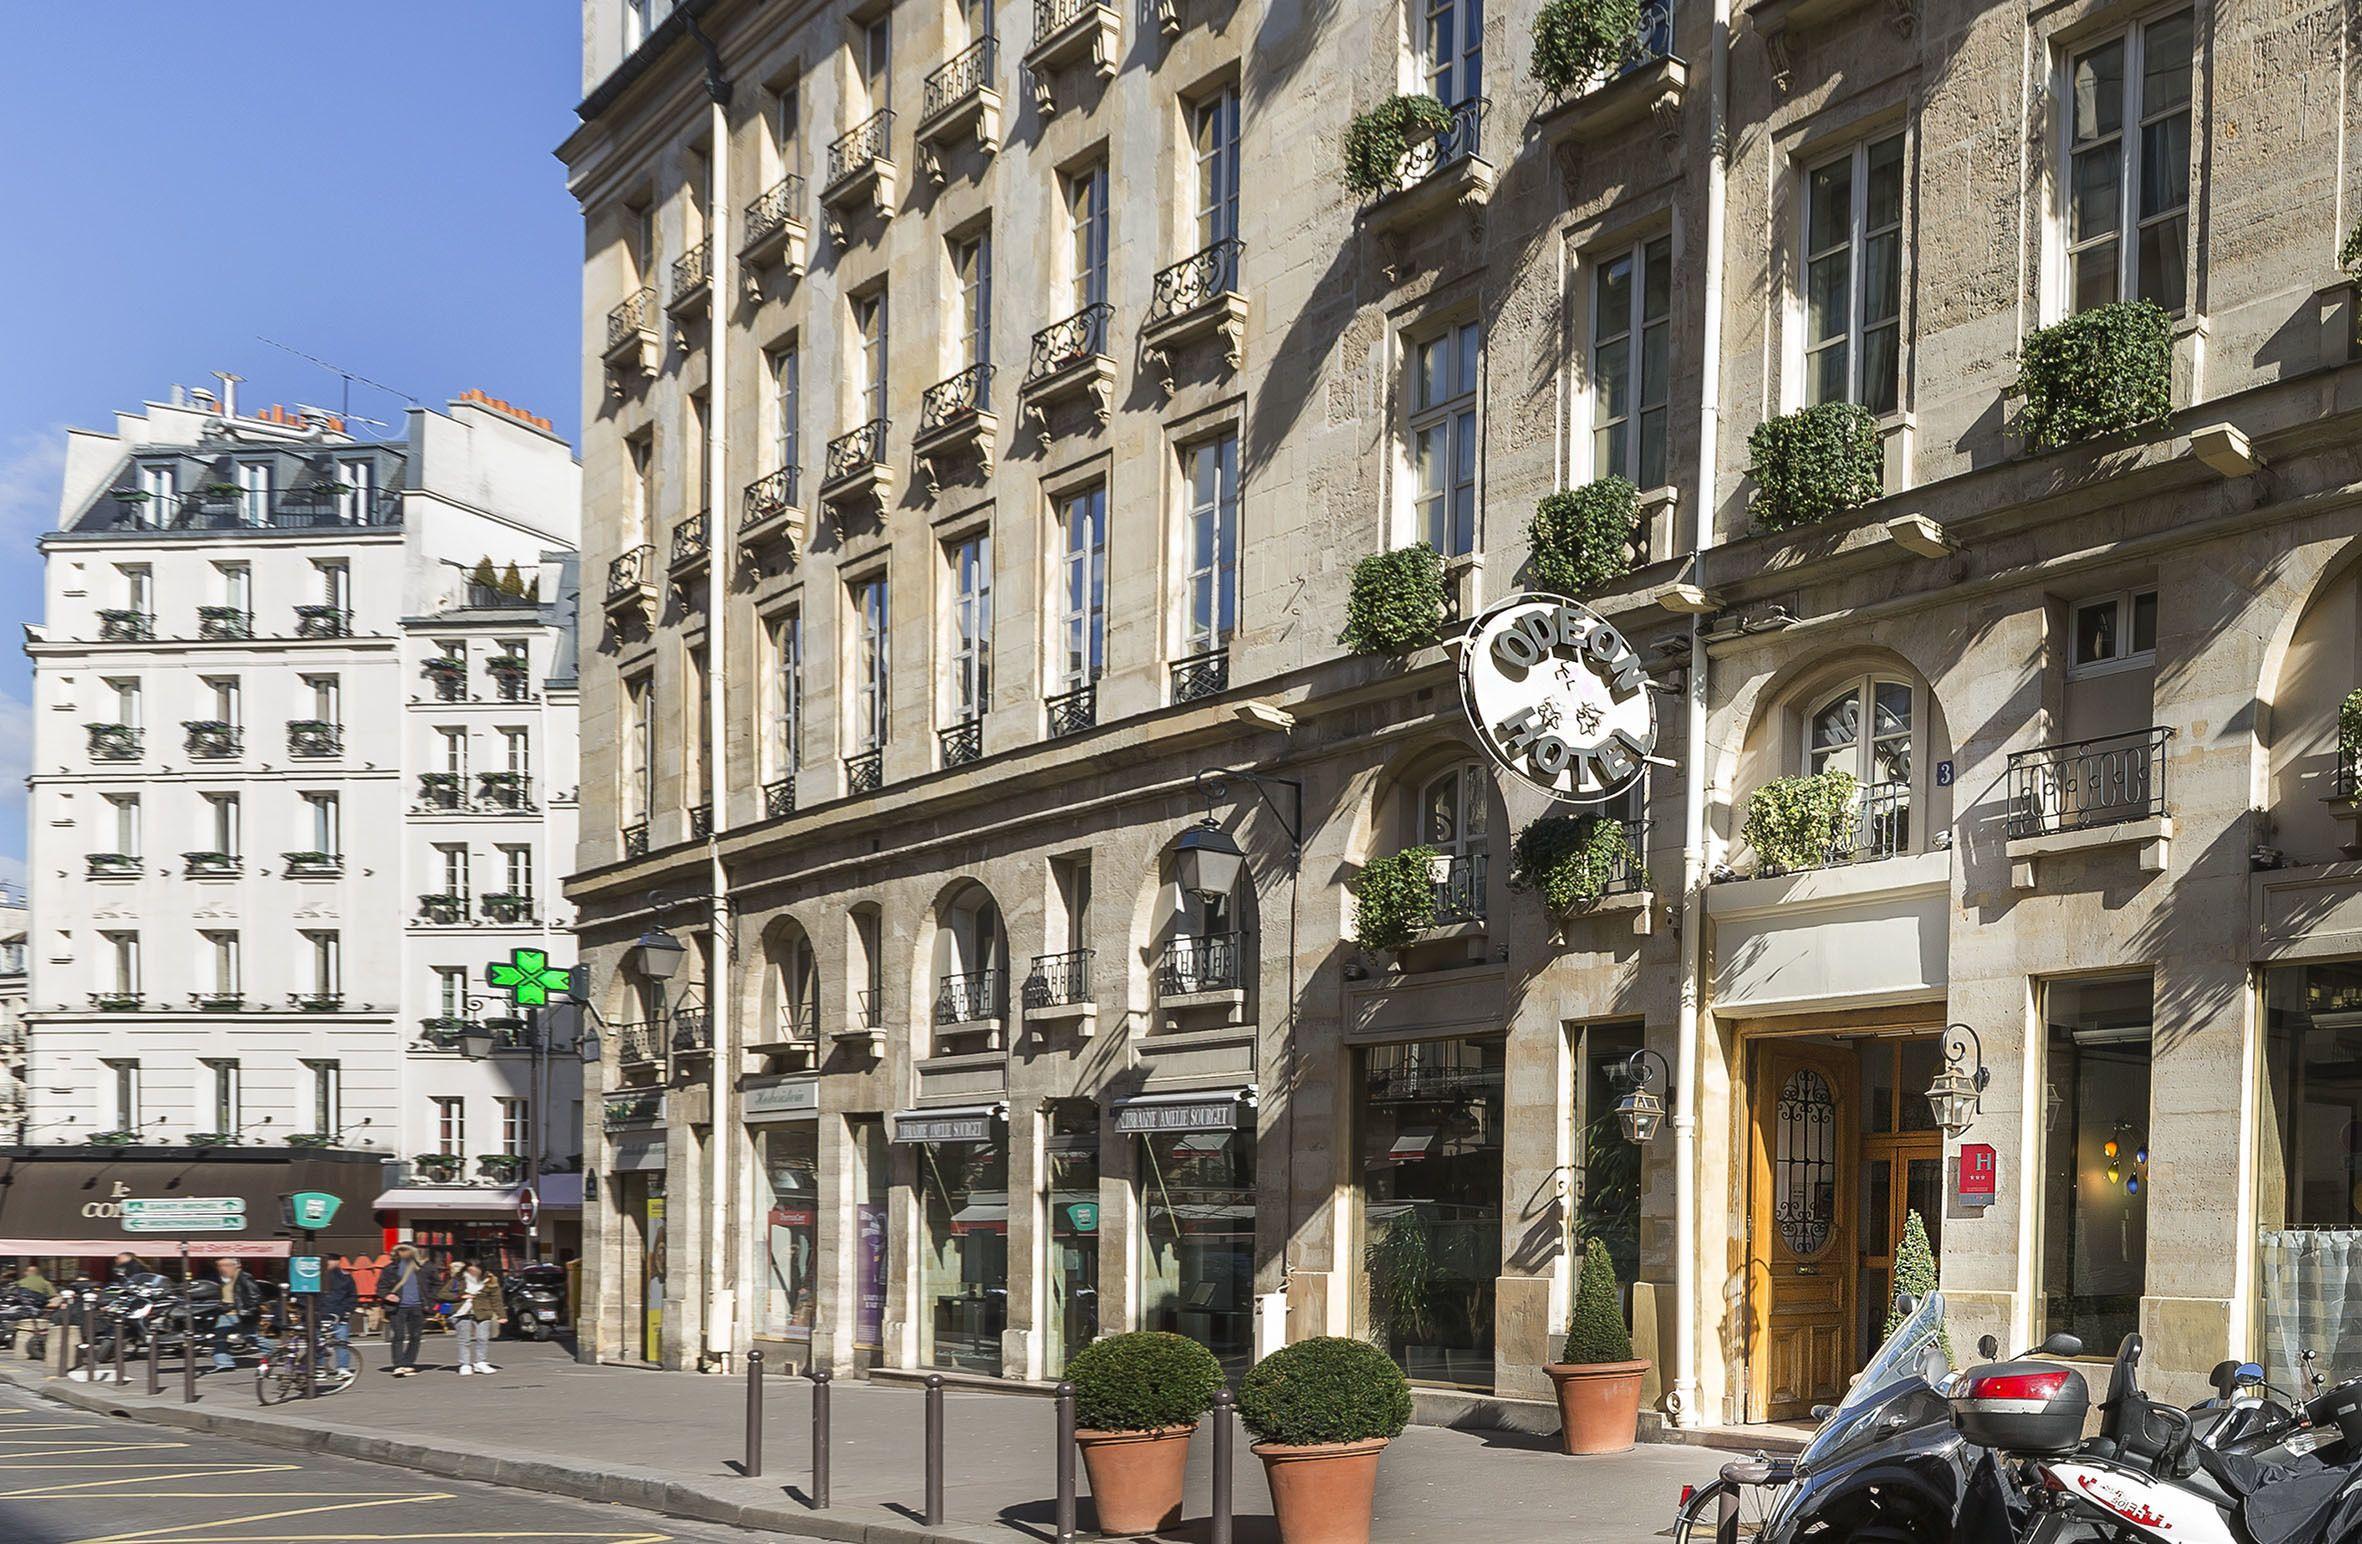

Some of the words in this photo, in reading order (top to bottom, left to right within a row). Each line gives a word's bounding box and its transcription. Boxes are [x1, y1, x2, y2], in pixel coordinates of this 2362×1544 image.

[1492, 607, 1649, 693] ODEON
[1495, 705, 1653, 786] HOTEL
[1940, 763, 1951, 784] 3
[1976, 1153, 1992, 1171] H
